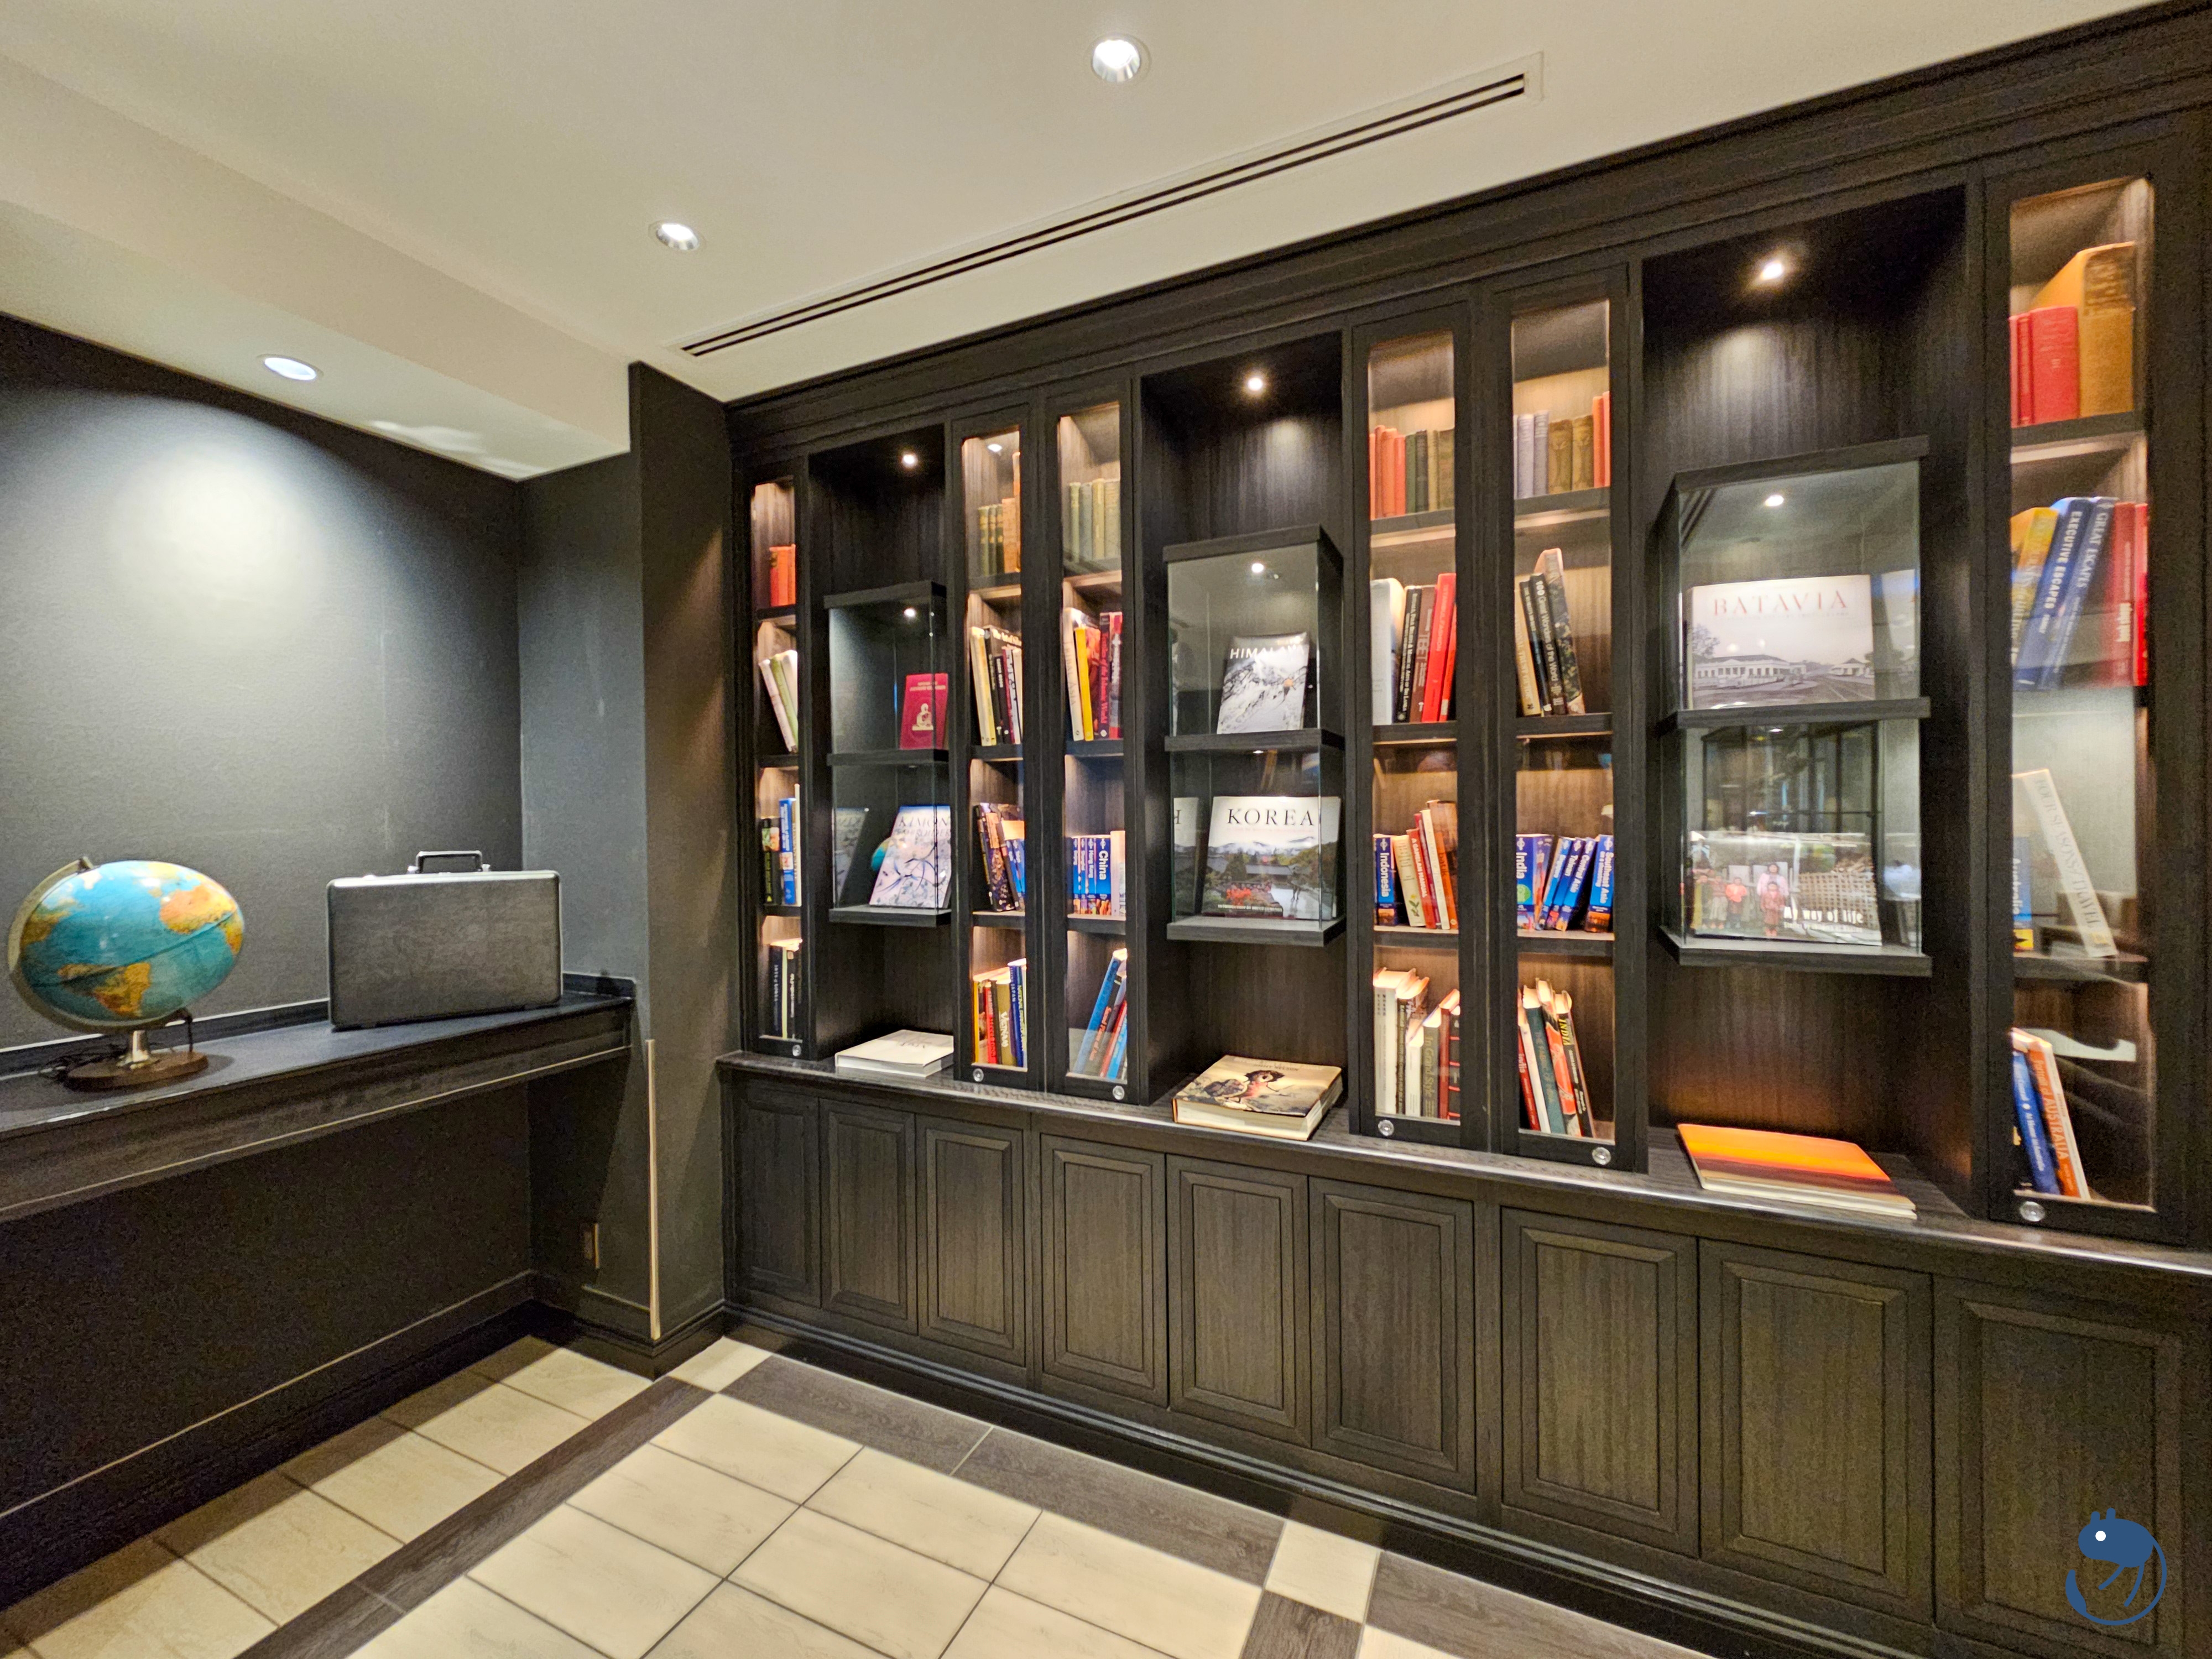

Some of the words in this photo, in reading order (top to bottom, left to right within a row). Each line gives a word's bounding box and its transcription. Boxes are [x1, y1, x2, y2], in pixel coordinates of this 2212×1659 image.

[2057, 510, 2083, 564] EXECUTIVE
[2091, 513, 2109, 546] GREAT
[2077, 547, 2097, 589] ESCAPES
[1535, 580, 1545, 596] 100
[2044, 565, 2066, 609] ESCAPES
[1537, 596, 1548, 614] Great
[1714, 590, 1847, 616] BATAVIA
[1540, 614, 1552, 643] Wonders
[1415, 631, 1430, 662] TIBET
[1548, 661, 1558, 681] World
[1227, 808, 1314, 826] KOREA
[1099, 851, 1108, 880] China
[1379, 852, 1391, 897] Indonesia
[1411, 843, 1423, 872] GAMELAN
[1417, 872, 1428, 898] MANUAL
[1437, 852, 1448, 877] batik
[1514, 851, 1528, 879] India
[1564, 853, 1578, 878] Taiwan
[1575, 853, 1590, 879] Central
[1602, 852, 1614, 887] Southeast
[1570, 878, 1581, 894] Asia
[1600, 888, 1609, 904] Asia
[1802, 910, 1822, 922] way
[1827, 909, 1838, 922] of
[1843, 909, 1864, 924] life
[1425, 1036, 1433, 1046] In
[1557, 1017, 1571, 1046] INDIA
[1425, 1047, 1434, 1075] Grand
[1424, 1076, 1434, 1098] Style
[2044, 1098, 2070, 1159] AUSTRALIA
